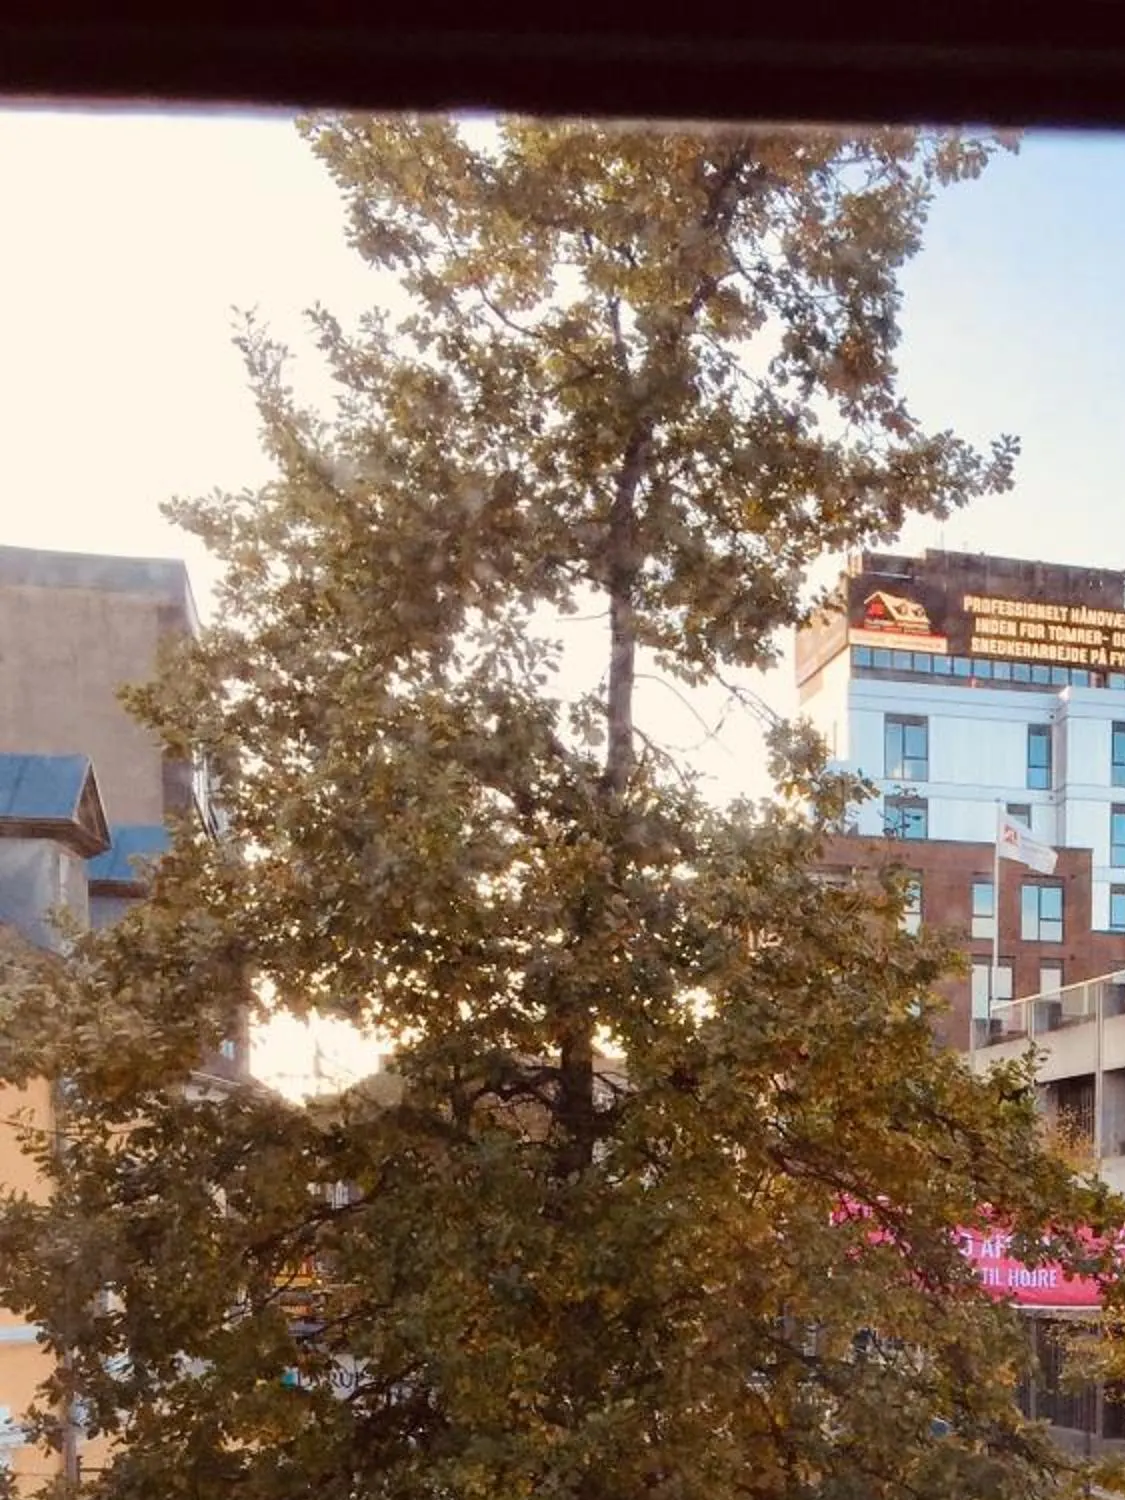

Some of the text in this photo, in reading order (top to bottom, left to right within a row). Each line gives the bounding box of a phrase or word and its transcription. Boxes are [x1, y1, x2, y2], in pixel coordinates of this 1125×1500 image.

[964, 595, 1069, 622] PROFESSIONELT
[975, 617, 1017, 636] INDEN
[1020, 622, 1045, 640] FOR
[1090, 647, 1107, 665] PÅ
[981, 1268, 1001, 1286] TIL
